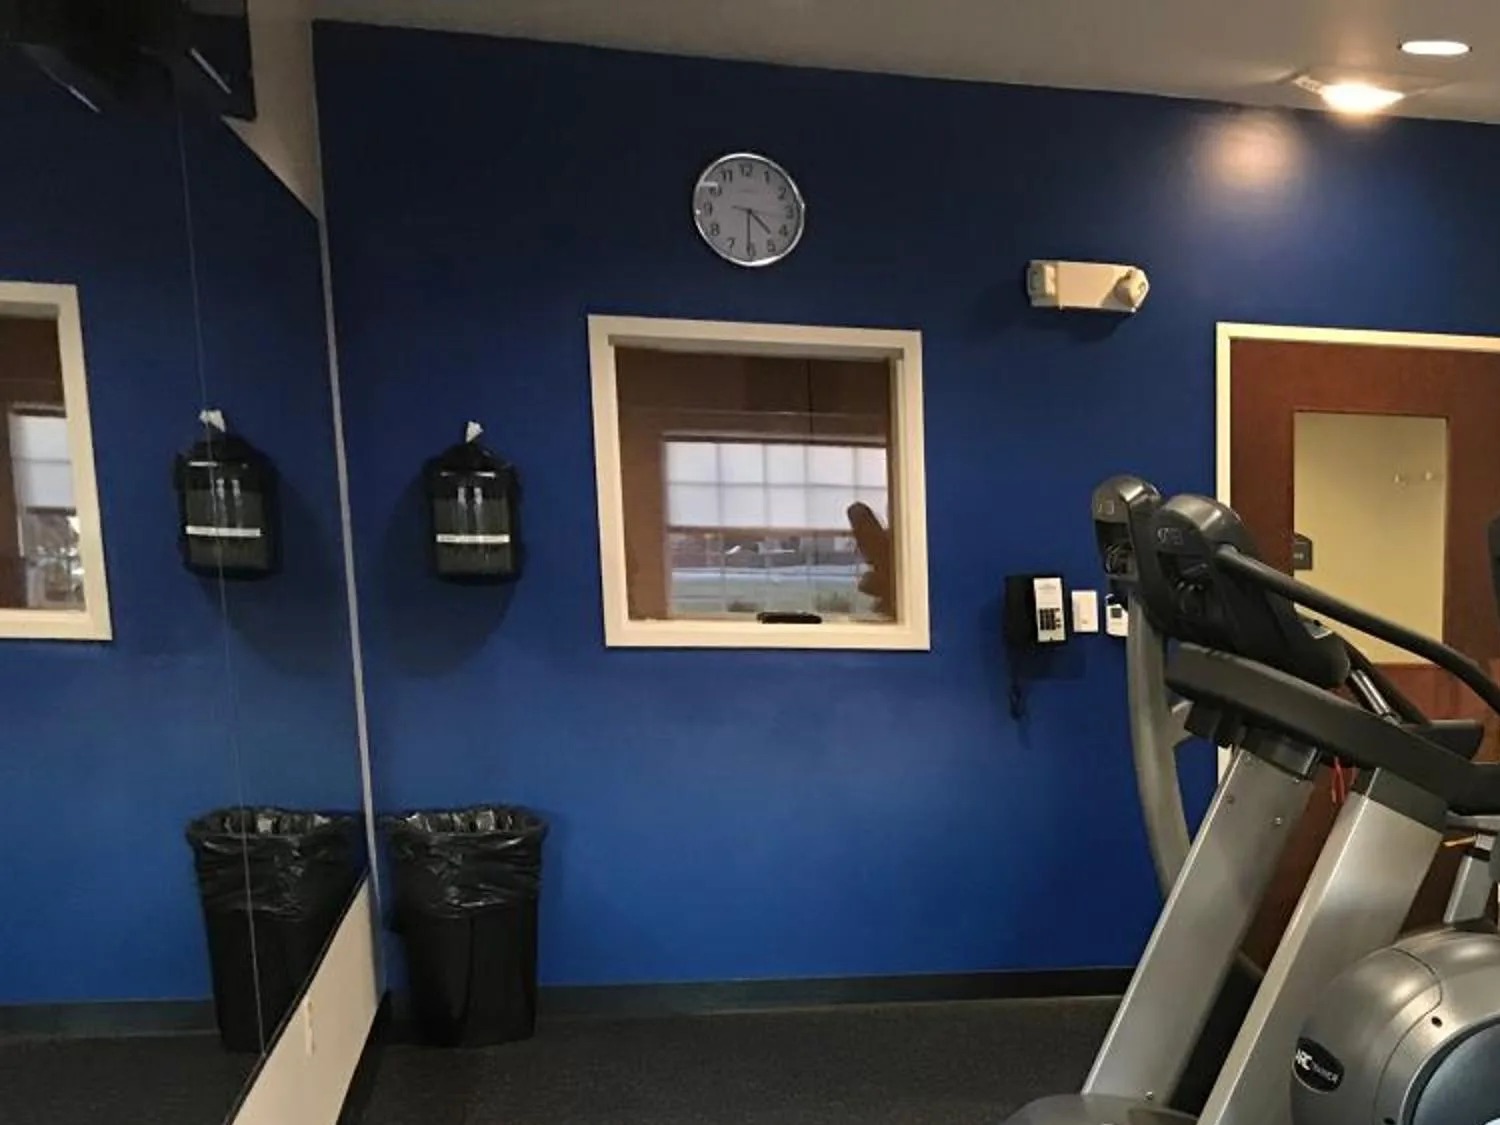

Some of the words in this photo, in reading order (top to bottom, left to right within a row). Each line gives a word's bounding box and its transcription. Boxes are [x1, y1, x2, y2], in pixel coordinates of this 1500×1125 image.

[721, 167, 733, 183] 11
[763, 170, 770, 184] 1
[778, 186, 787, 200] 2
[785, 204, 794, 219] 3
[710, 222, 720, 236] 8
[779, 223, 788, 237] 4
[727, 237, 736, 250] 7
[766, 238, 776, 253] 5
